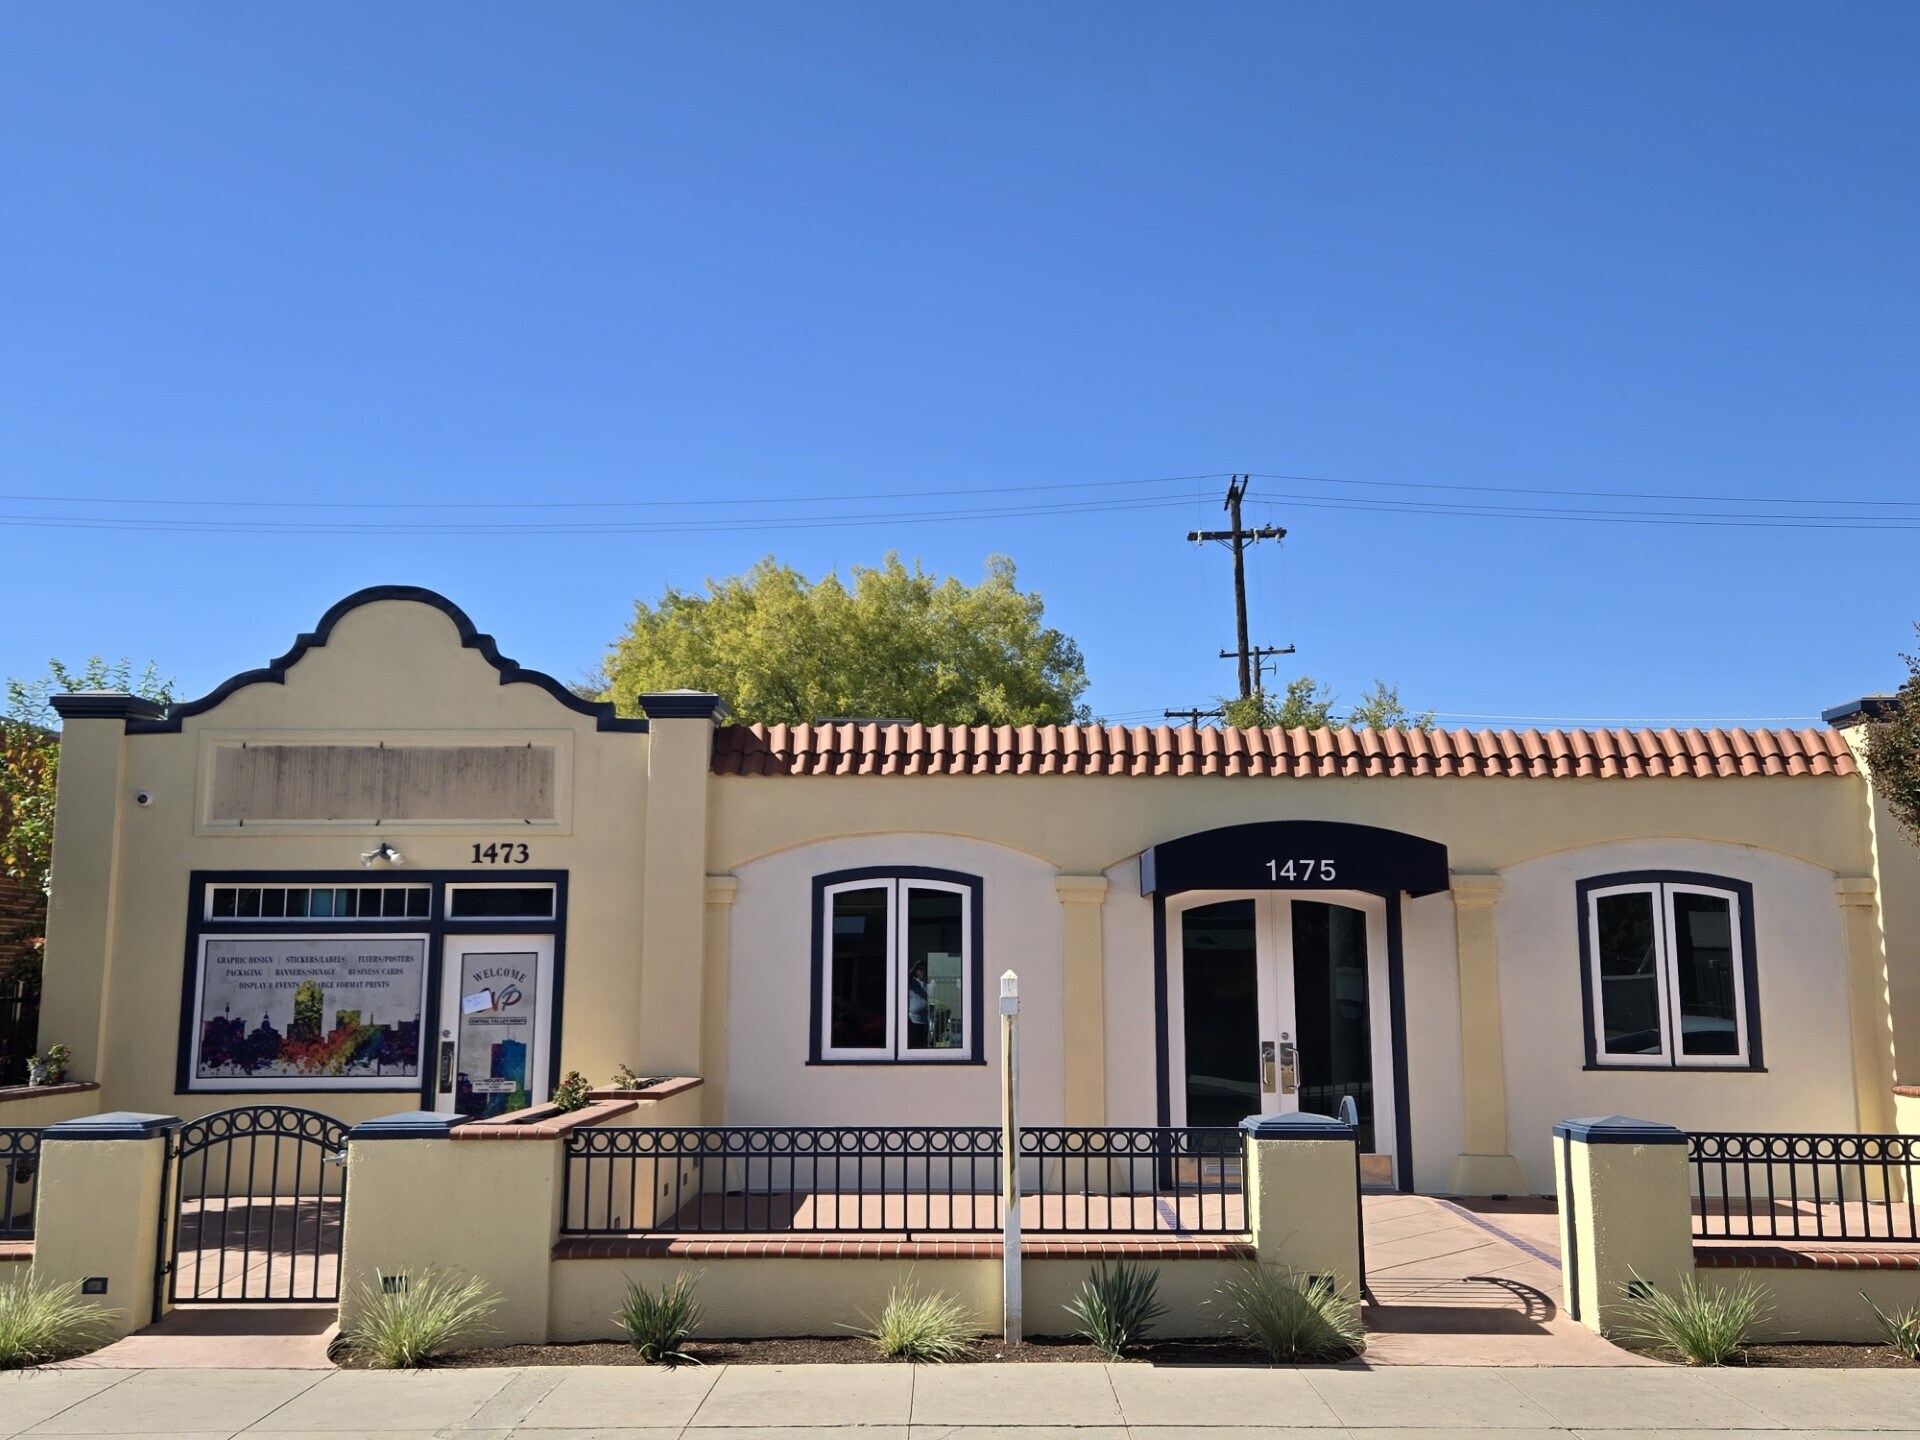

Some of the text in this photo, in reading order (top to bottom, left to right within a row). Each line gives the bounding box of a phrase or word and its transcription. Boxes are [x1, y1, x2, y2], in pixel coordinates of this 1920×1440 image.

[471, 843, 529, 864] 1473
[1265, 859, 1336, 881] 1475
[217, 955, 415, 965] GRAPHIC DESIGN STICKERS/LABELS FLYERS/POSTERS
[226, 968, 404, 977] PACKAGING BANNERS/SIGNAGE BUSINESS CARDS
[473, 967, 527, 983] WELCOME
[239, 981, 266, 990] DISPLAY
[275, 981, 300, 990] EVENTS
[336, 981, 363, 989] FORMAT
[364, 981, 391, 989] PRINTS
[475, 983, 523, 1013] VP
